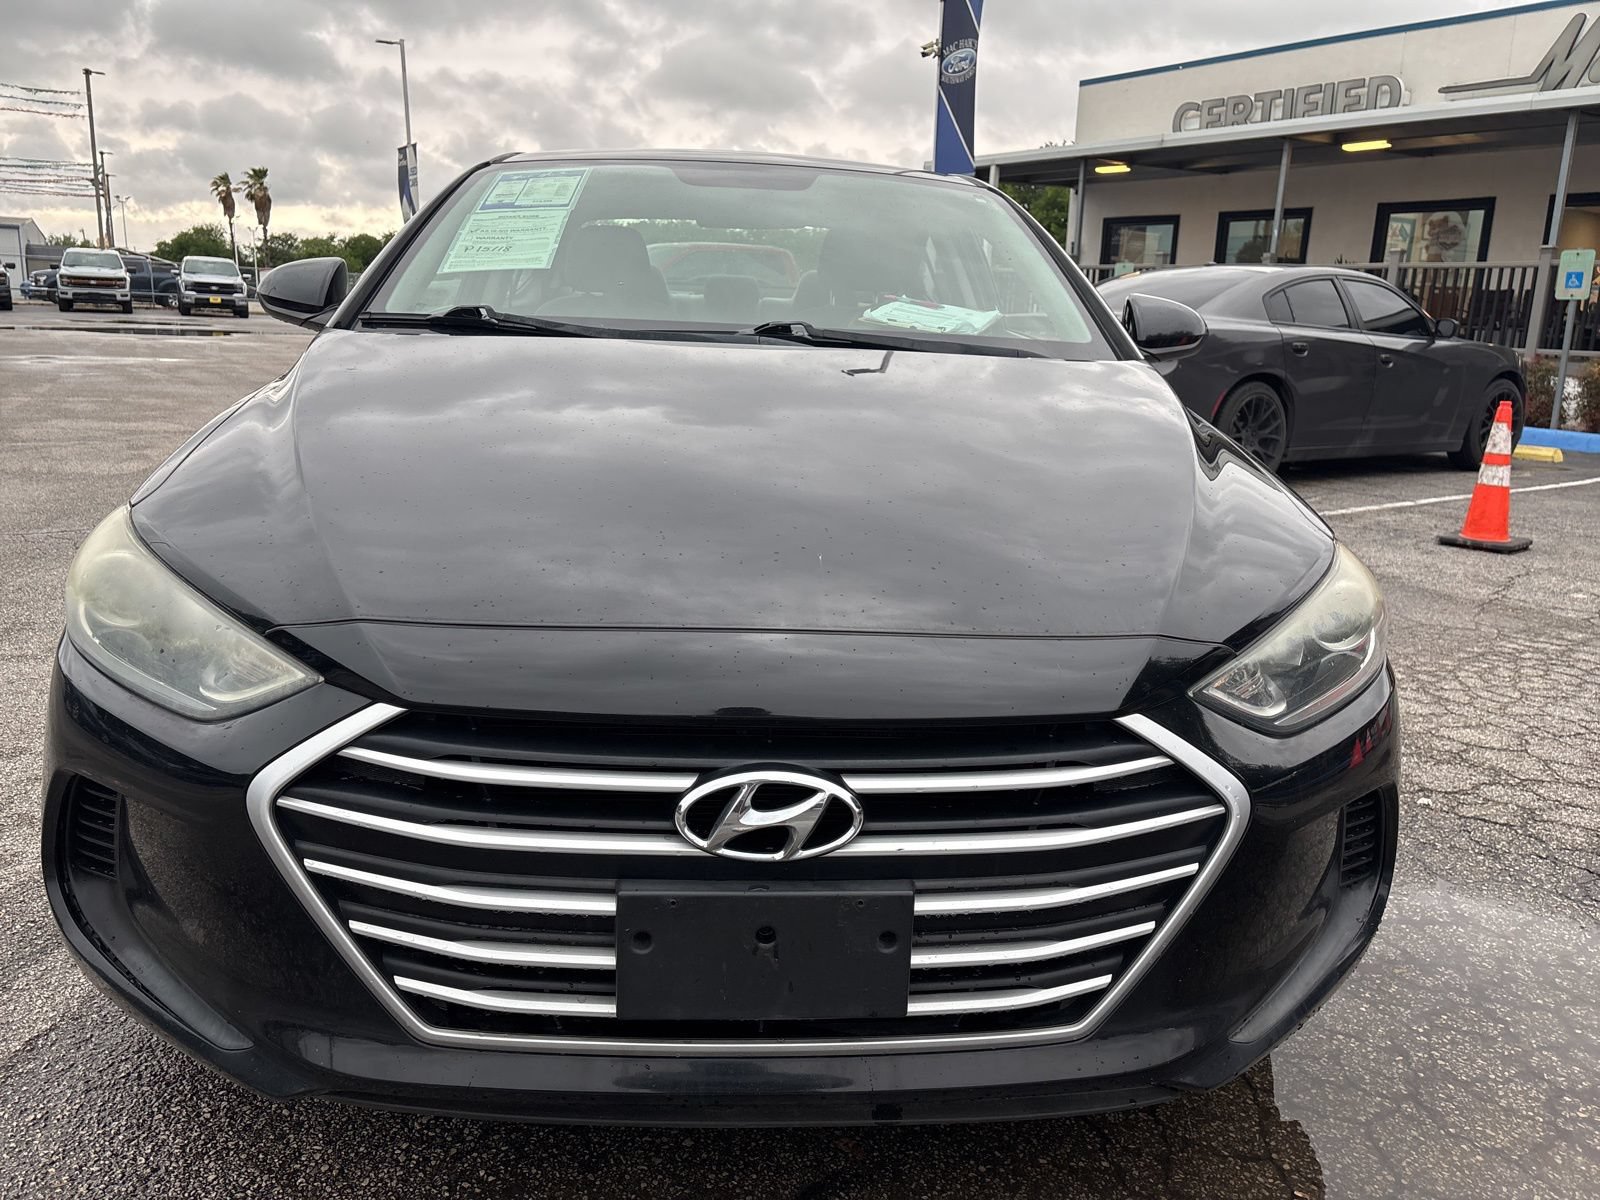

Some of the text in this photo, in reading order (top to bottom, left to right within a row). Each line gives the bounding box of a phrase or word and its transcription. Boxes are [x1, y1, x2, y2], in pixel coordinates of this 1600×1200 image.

[948, 53, 971, 73] Ford
[1438, 12, 1600, 93] M
[1171, 74, 1404, 132] CERTIFIED
